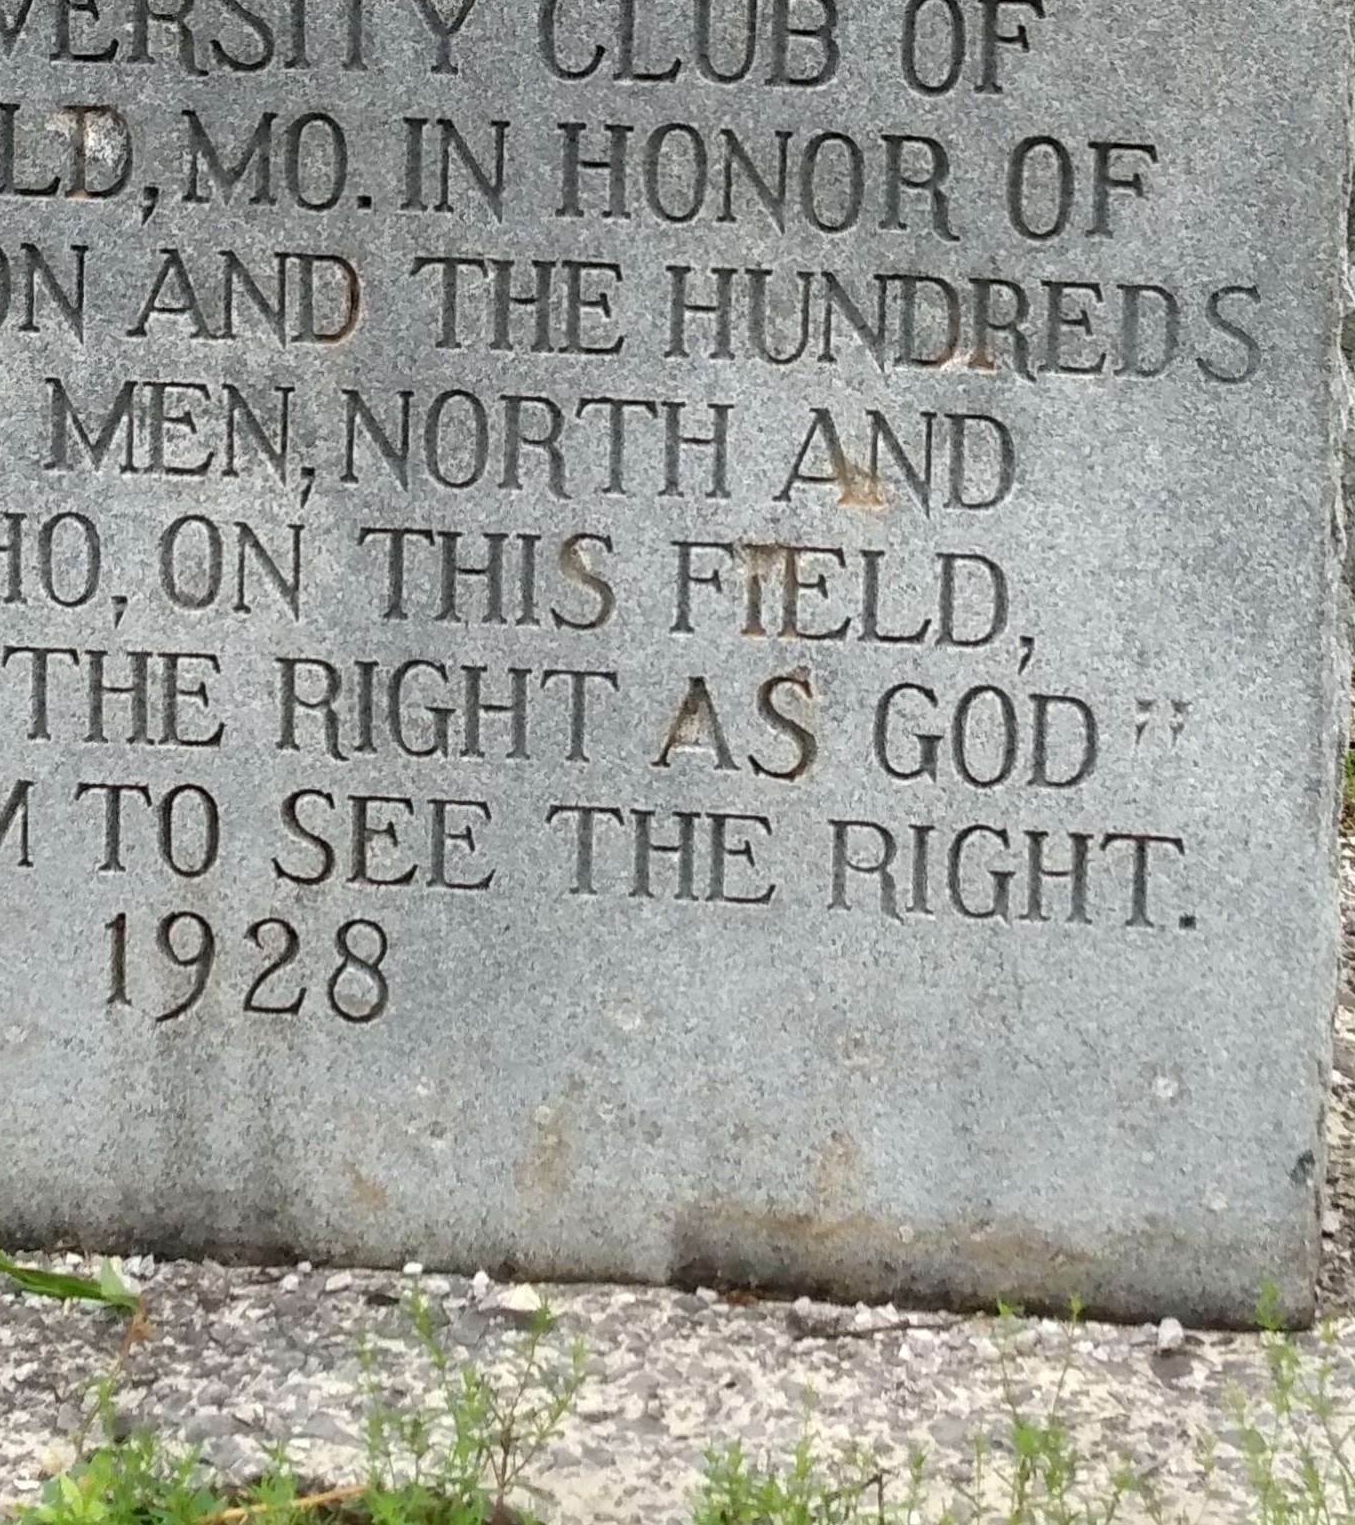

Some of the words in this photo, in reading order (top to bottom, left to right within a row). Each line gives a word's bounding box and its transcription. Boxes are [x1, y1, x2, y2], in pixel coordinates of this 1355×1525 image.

[181, 108, 373, 212] MO.
[400, 117, 511, 222] IN
[555, 121, 960, 241] HONOR
[1005, 134, 1160, 242] OF
[126, 247, 363, 348] AND
[408, 255, 625, 355] THE
[664, 266, 1262, 384] HUNDREDS
[44, 377, 316, 508] MEN,
[341, 389, 734, 500] NORTH
[773, 408, 1016, 519] AND
[158, 513, 305, 620] ON
[357, 527, 617, 630] THIS
[669, 541, 1036, 674] FIELD,
[2, 644, 226, 749] THE
[275, 656, 620, 762] RIGHT
[650, 675, 819, 780] AS
[74, 781, 221, 878] TO
[272, 788, 497, 891] SEE
[545, 804, 777, 906] THE
[827, 818, 1197, 929] RIGHT.
[104, 910, 389, 1024] 1928
